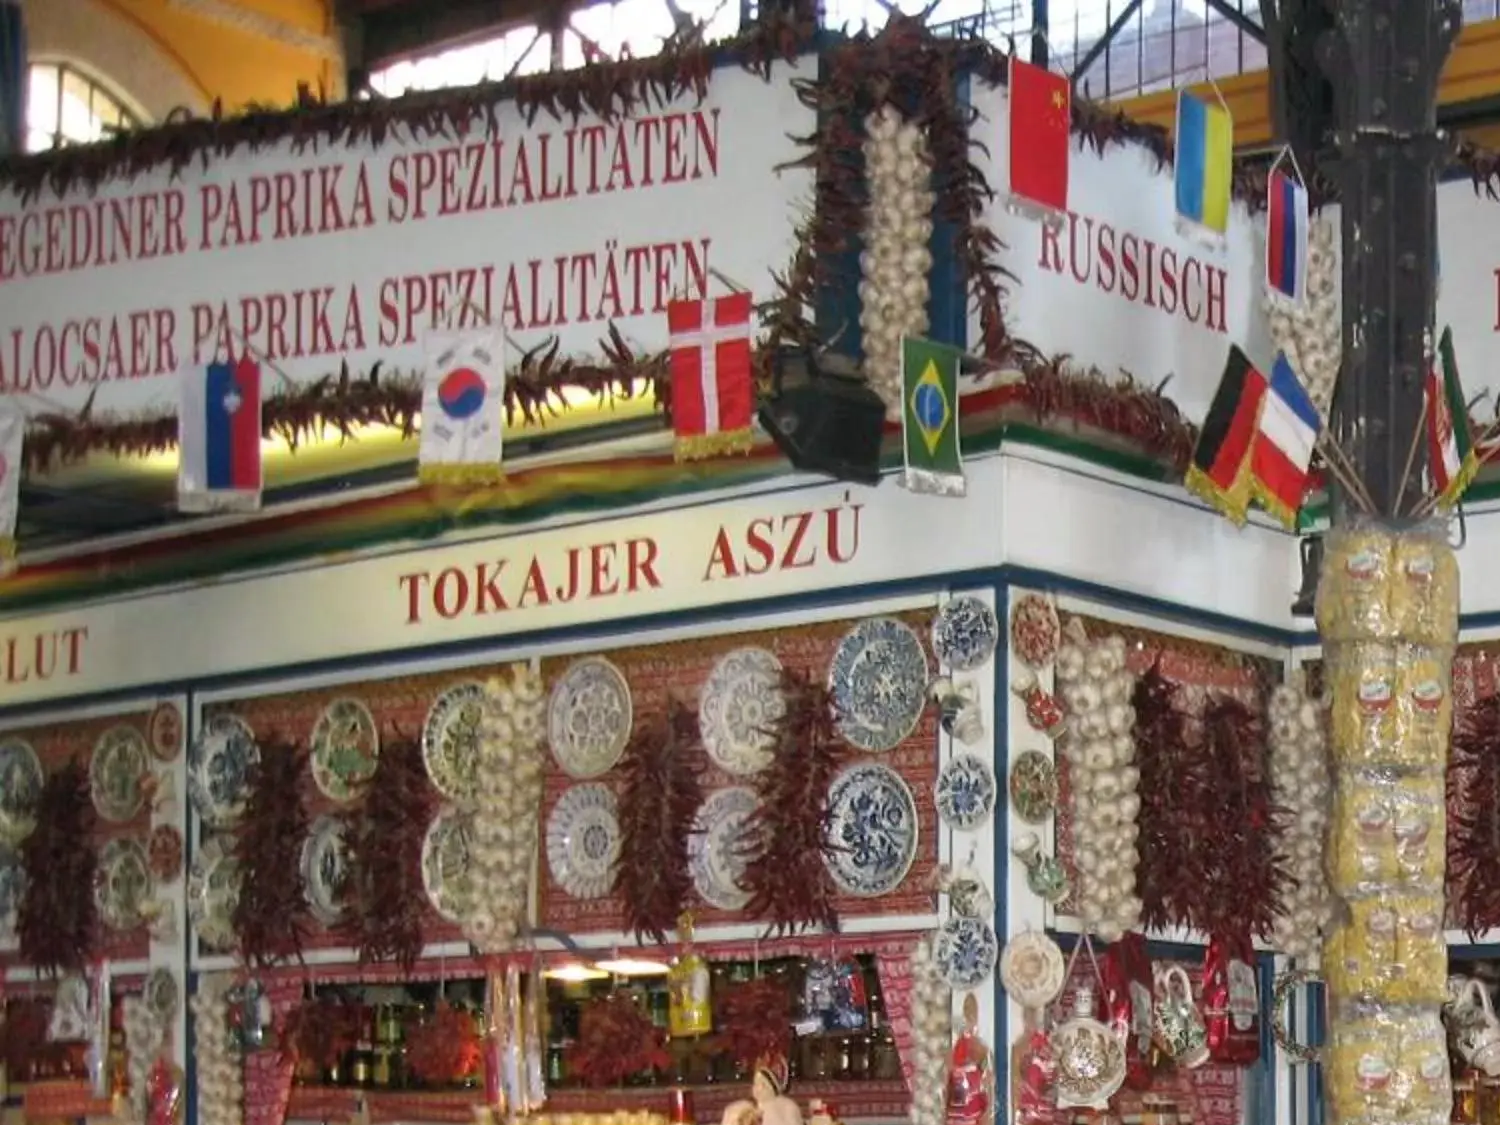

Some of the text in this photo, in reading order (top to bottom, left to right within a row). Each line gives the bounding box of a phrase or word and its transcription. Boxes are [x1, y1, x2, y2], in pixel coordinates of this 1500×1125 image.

[200, 159, 374, 250] PAPRIKA
[387, 109, 720, 223] SPEZIALITÄTEN
[190, 283, 365, 367] PAPRIKA
[378, 238, 711, 347] SPEZIALITÄTEN
[1037, 211, 1228, 333] RUSSISCH
[399, 491, 865, 624] TOKAJER ASZÚ
